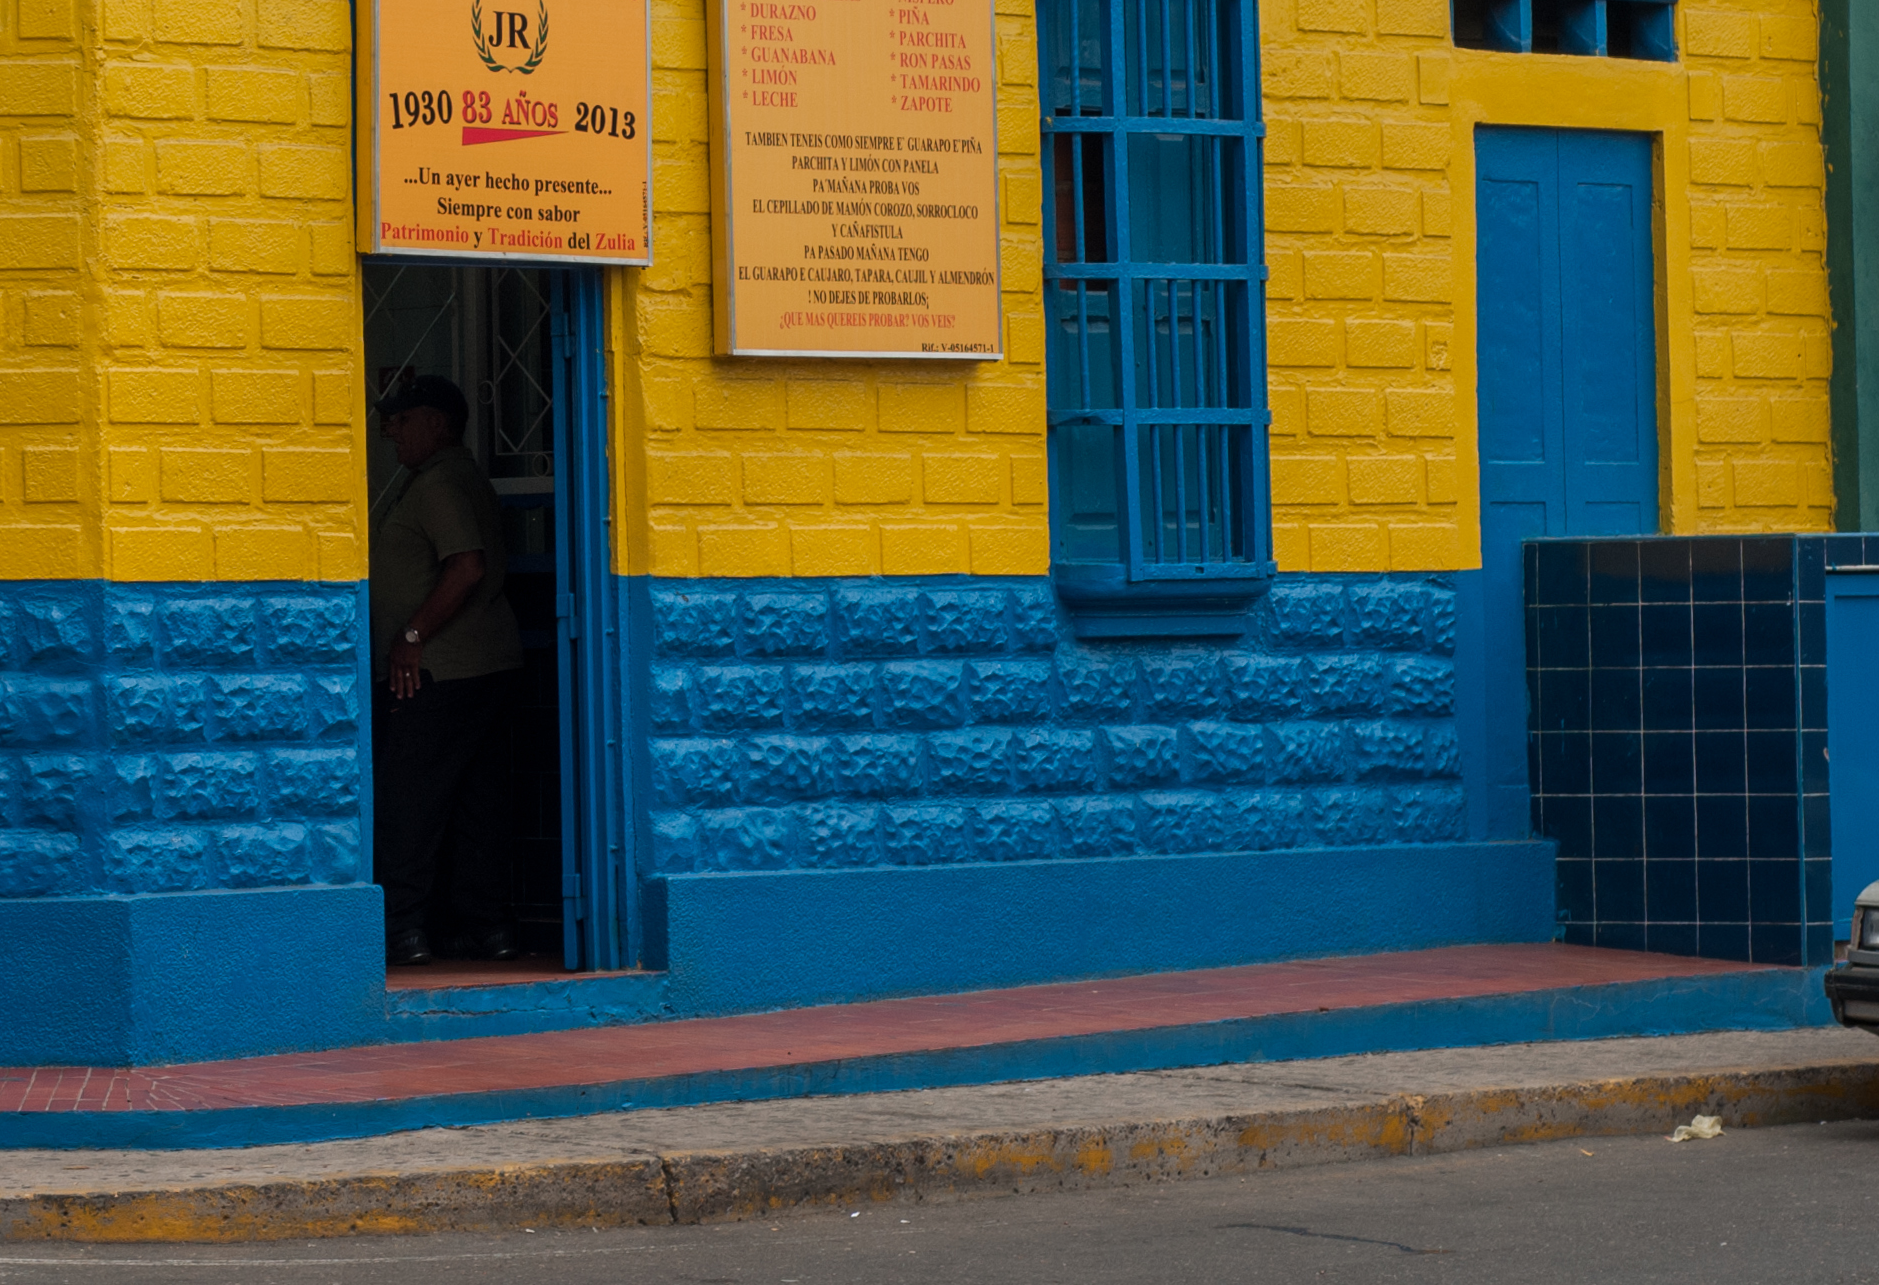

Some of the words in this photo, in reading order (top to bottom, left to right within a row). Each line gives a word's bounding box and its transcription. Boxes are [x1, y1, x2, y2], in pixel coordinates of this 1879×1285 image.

[750, 2, 817, 22] DURAZNO
[898, 6, 930, 26] PIÑA
[488, 10, 532, 50] JR
[751, 24, 794, 42] FRESA
[899, 30, 967, 49] PARCHITA
[751, 46, 836, 66] GUANABANA
[900, 52, 928, 68] RON
[931, 54, 972, 71] PASAS
[752, 65, 798, 86] LIMÓN
[900, 73, 981, 93] TAMARINDO
[752, 90, 798, 108] LECHE
[900, 95, 953, 113] ZAPOTE
[389, 89, 453, 130] 1930
[462, 89, 492, 124] 83
[501, 90, 559, 128] AÑOS
[574, 101, 636, 140] 2013
[791, 155, 839, 171] PARCHITA
[849, 154, 881, 172] LIMÓN
[882, 158, 902, 173] CON
[903, 159, 939, 174] PANELA
[445, 172, 481, 191] ayer
[485, 170, 530, 192] hecho
[869, 179, 900, 195] PROBA
[901, 181, 920, 196] VOS
[437, 197, 502, 221] Siempre
[506, 205, 533, 220] con
[537, 204, 581, 223] sabor
[752, 199, 765, 213] EL
[766, 200, 820, 215] CEPILLADO
[821, 201, 834, 215] DE
[836, 199, 872, 216] MAMÓN
[380, 222, 469, 244] Patrimonio
[474, 232, 483, 248] y
[487, 227, 563, 249] Tradición
[567, 231, 591, 250] del
[595, 232, 636, 251] Zulia
[804, 245, 816, 259] PA
[818, 245, 855, 260] PASADO
[856, 243, 896, 261] MAÑANA
[897, 247, 929, 262] TENGO
